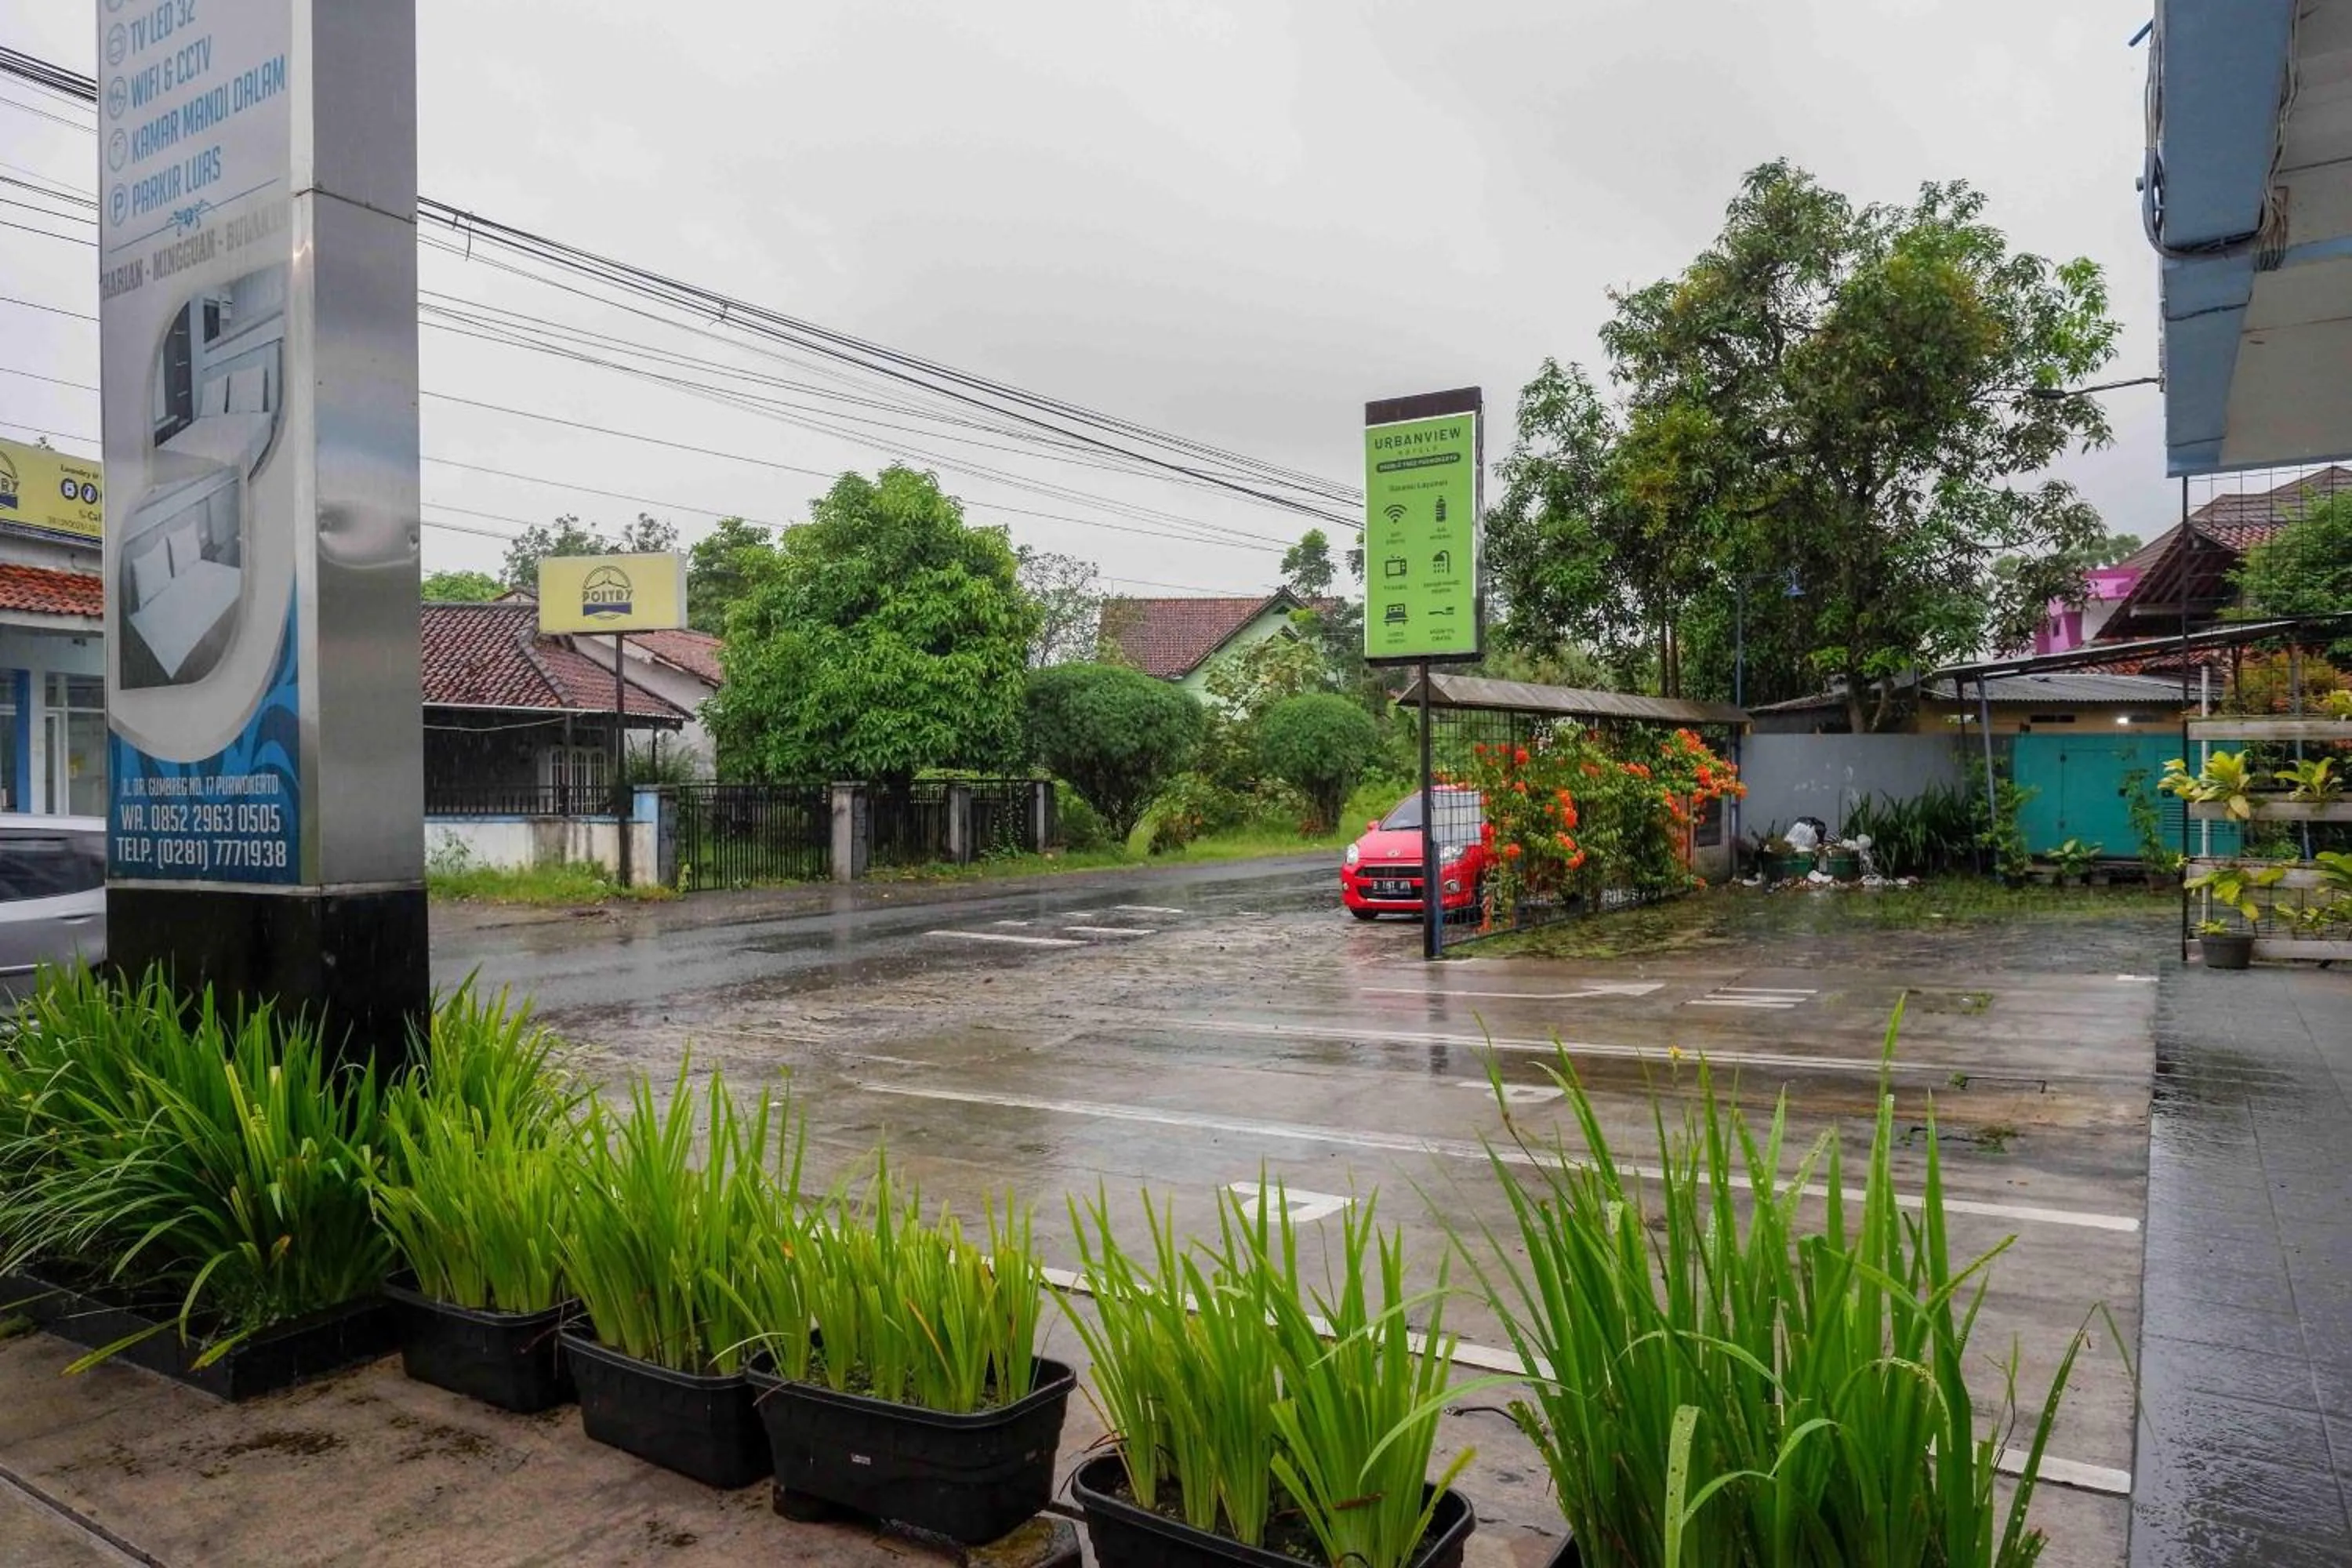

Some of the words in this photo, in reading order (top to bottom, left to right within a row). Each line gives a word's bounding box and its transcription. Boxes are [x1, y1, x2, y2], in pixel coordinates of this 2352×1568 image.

[129, 16, 147, 55] TV
[150, 1, 173, 44] LED
[131, 63, 160, 109] WIFI
[164, 57, 173, 92] &
[176, 34, 212, 85] CCTV
[132, 110, 179, 163] KAMAR
[183, 82, 229, 138] MANDI
[234, 53, 285, 114] DALAM
[114, 193, 123, 220] P
[132, 165, 181, 216] PARKIR
[186, 145, 221, 194] LUAS
[102, 259, 143, 302] HARIAN
[153, 228, 216, 281] MINGGUAN
[1374, 426, 1461, 450] URBANVIEW
[216, 775, 279, 796] PURWOKERTO
[120, 804, 147, 831] WA.
[151, 804, 188, 832] 0852
[194, 804, 234, 833] 2963
[238, 804, 281, 833] 0505
[115, 837, 153, 862] TELP.
[158, 839, 209, 871] (0281)
[212, 840, 288, 868] 7771938
